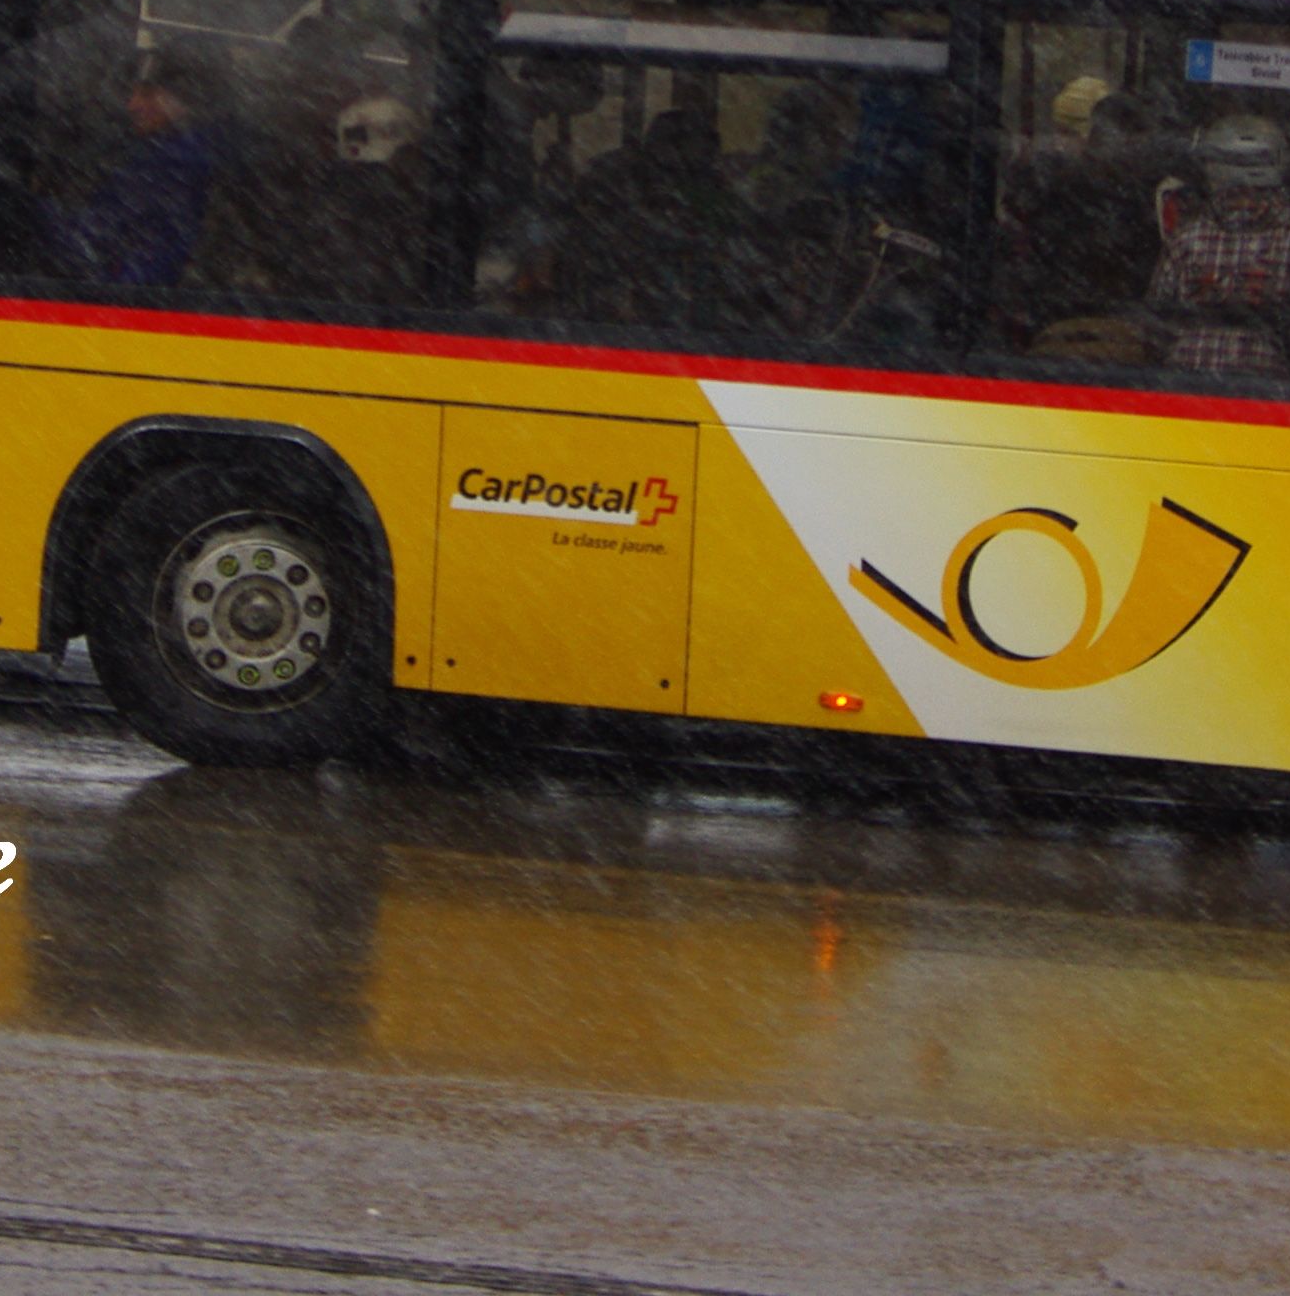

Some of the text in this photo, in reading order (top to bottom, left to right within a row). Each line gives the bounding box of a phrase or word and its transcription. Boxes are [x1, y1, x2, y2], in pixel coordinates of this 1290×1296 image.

[458, 467, 639, 515] CarPostal
[552, 532, 668, 555] La classe jaune.
